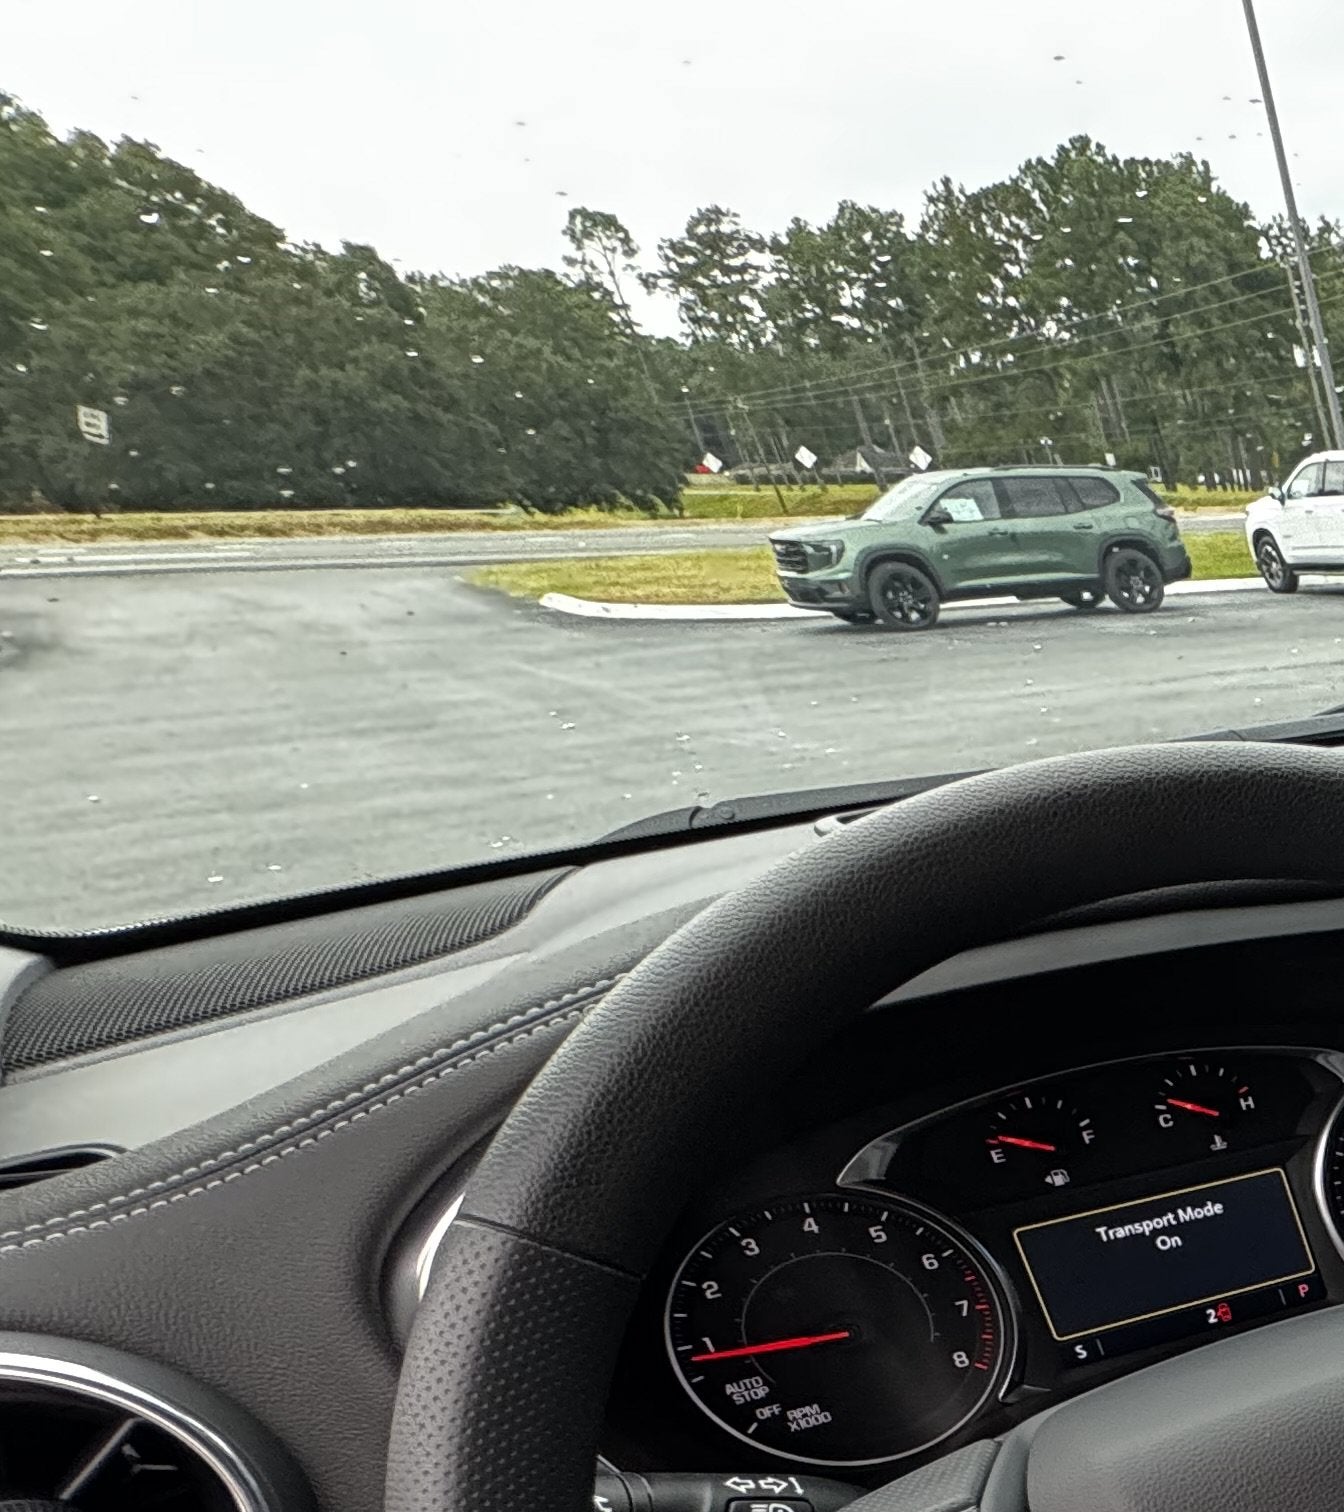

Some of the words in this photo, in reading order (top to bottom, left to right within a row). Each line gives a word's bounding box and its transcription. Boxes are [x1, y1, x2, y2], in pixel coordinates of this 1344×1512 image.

[1239, 1096, 1255, 1111] H
[1158, 1114, 1174, 1128] C
[1082, 1129, 1096, 1144] F
[990, 1149, 1006, 1164] E
[802, 1216, 820, 1235] 4
[1096, 1211, 1177, 1243] Transport
[1179, 1201, 1224, 1224] Mode
[868, 1226, 888, 1244] 5
[1155, 1234, 1182, 1251] On
[741, 1238, 760, 1257] 3
[922, 1252, 940, 1271] 6
[702, 1281, 722, 1300] 2
[954, 1300, 970, 1318] 7
[702, 1336, 716, 1353] 1
[1074, 1345, 1088, 1359] S
[952, 1351, 969, 1369] 8
[725, 1376, 763, 1396] AUTO
[733, 1385, 769, 1405] STOP
[755, 1404, 782, 1420] OFF
[787, 1404, 821, 1421] RPM
